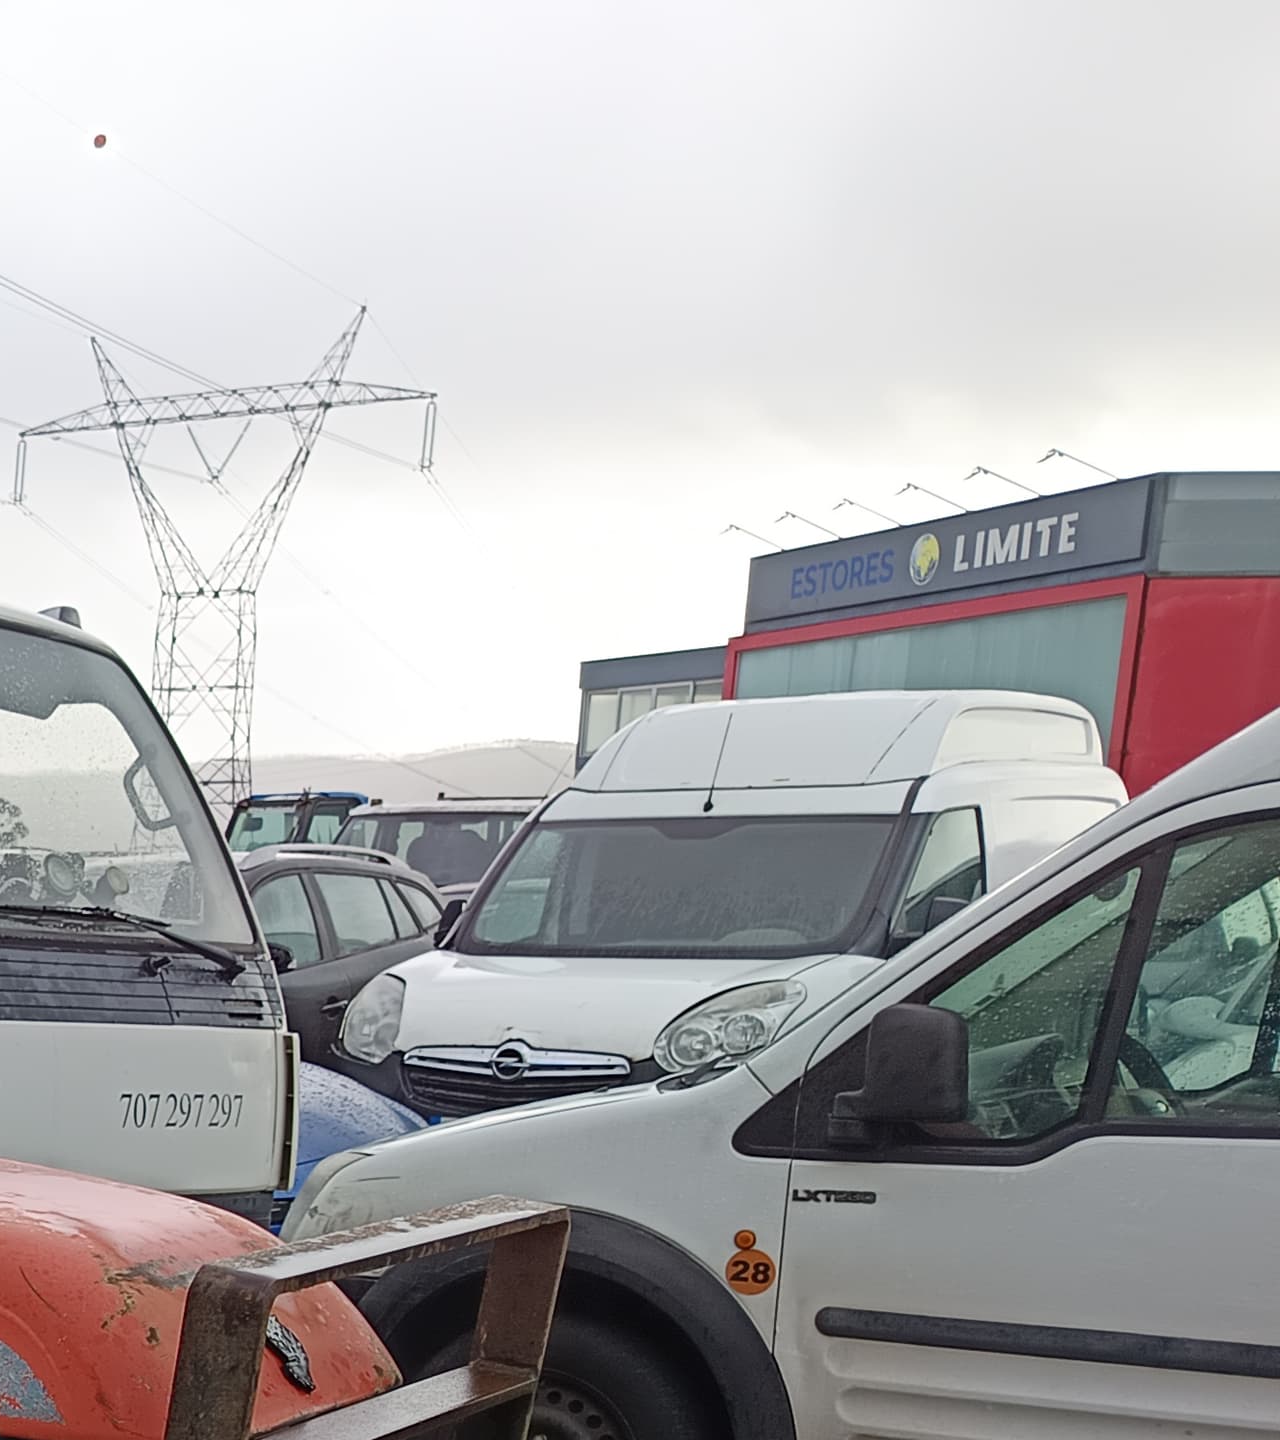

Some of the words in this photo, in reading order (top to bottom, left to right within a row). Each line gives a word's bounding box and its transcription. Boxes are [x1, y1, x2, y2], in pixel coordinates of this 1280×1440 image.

[791, 550, 895, 599] ESTORES
[953, 512, 1080, 573] LIMITE
[730, 1260, 771, 1284] 28
